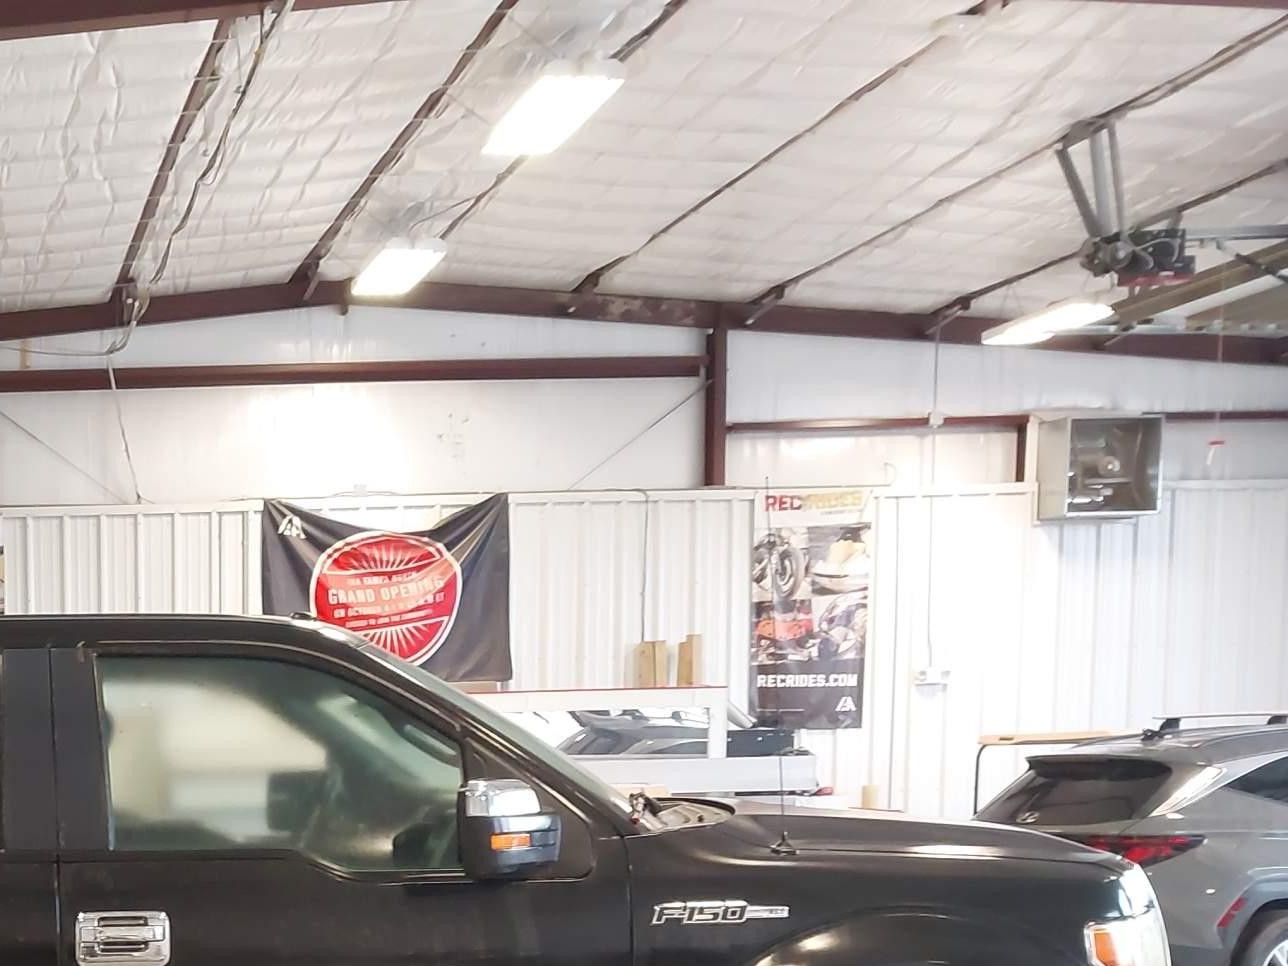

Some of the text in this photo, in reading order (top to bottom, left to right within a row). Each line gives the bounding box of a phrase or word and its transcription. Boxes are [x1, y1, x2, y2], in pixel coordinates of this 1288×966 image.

[327, 588, 376, 605] GRAND
[380, 575, 445, 601] OPENING
[756, 674, 858, 688] RECRIDES.COM
